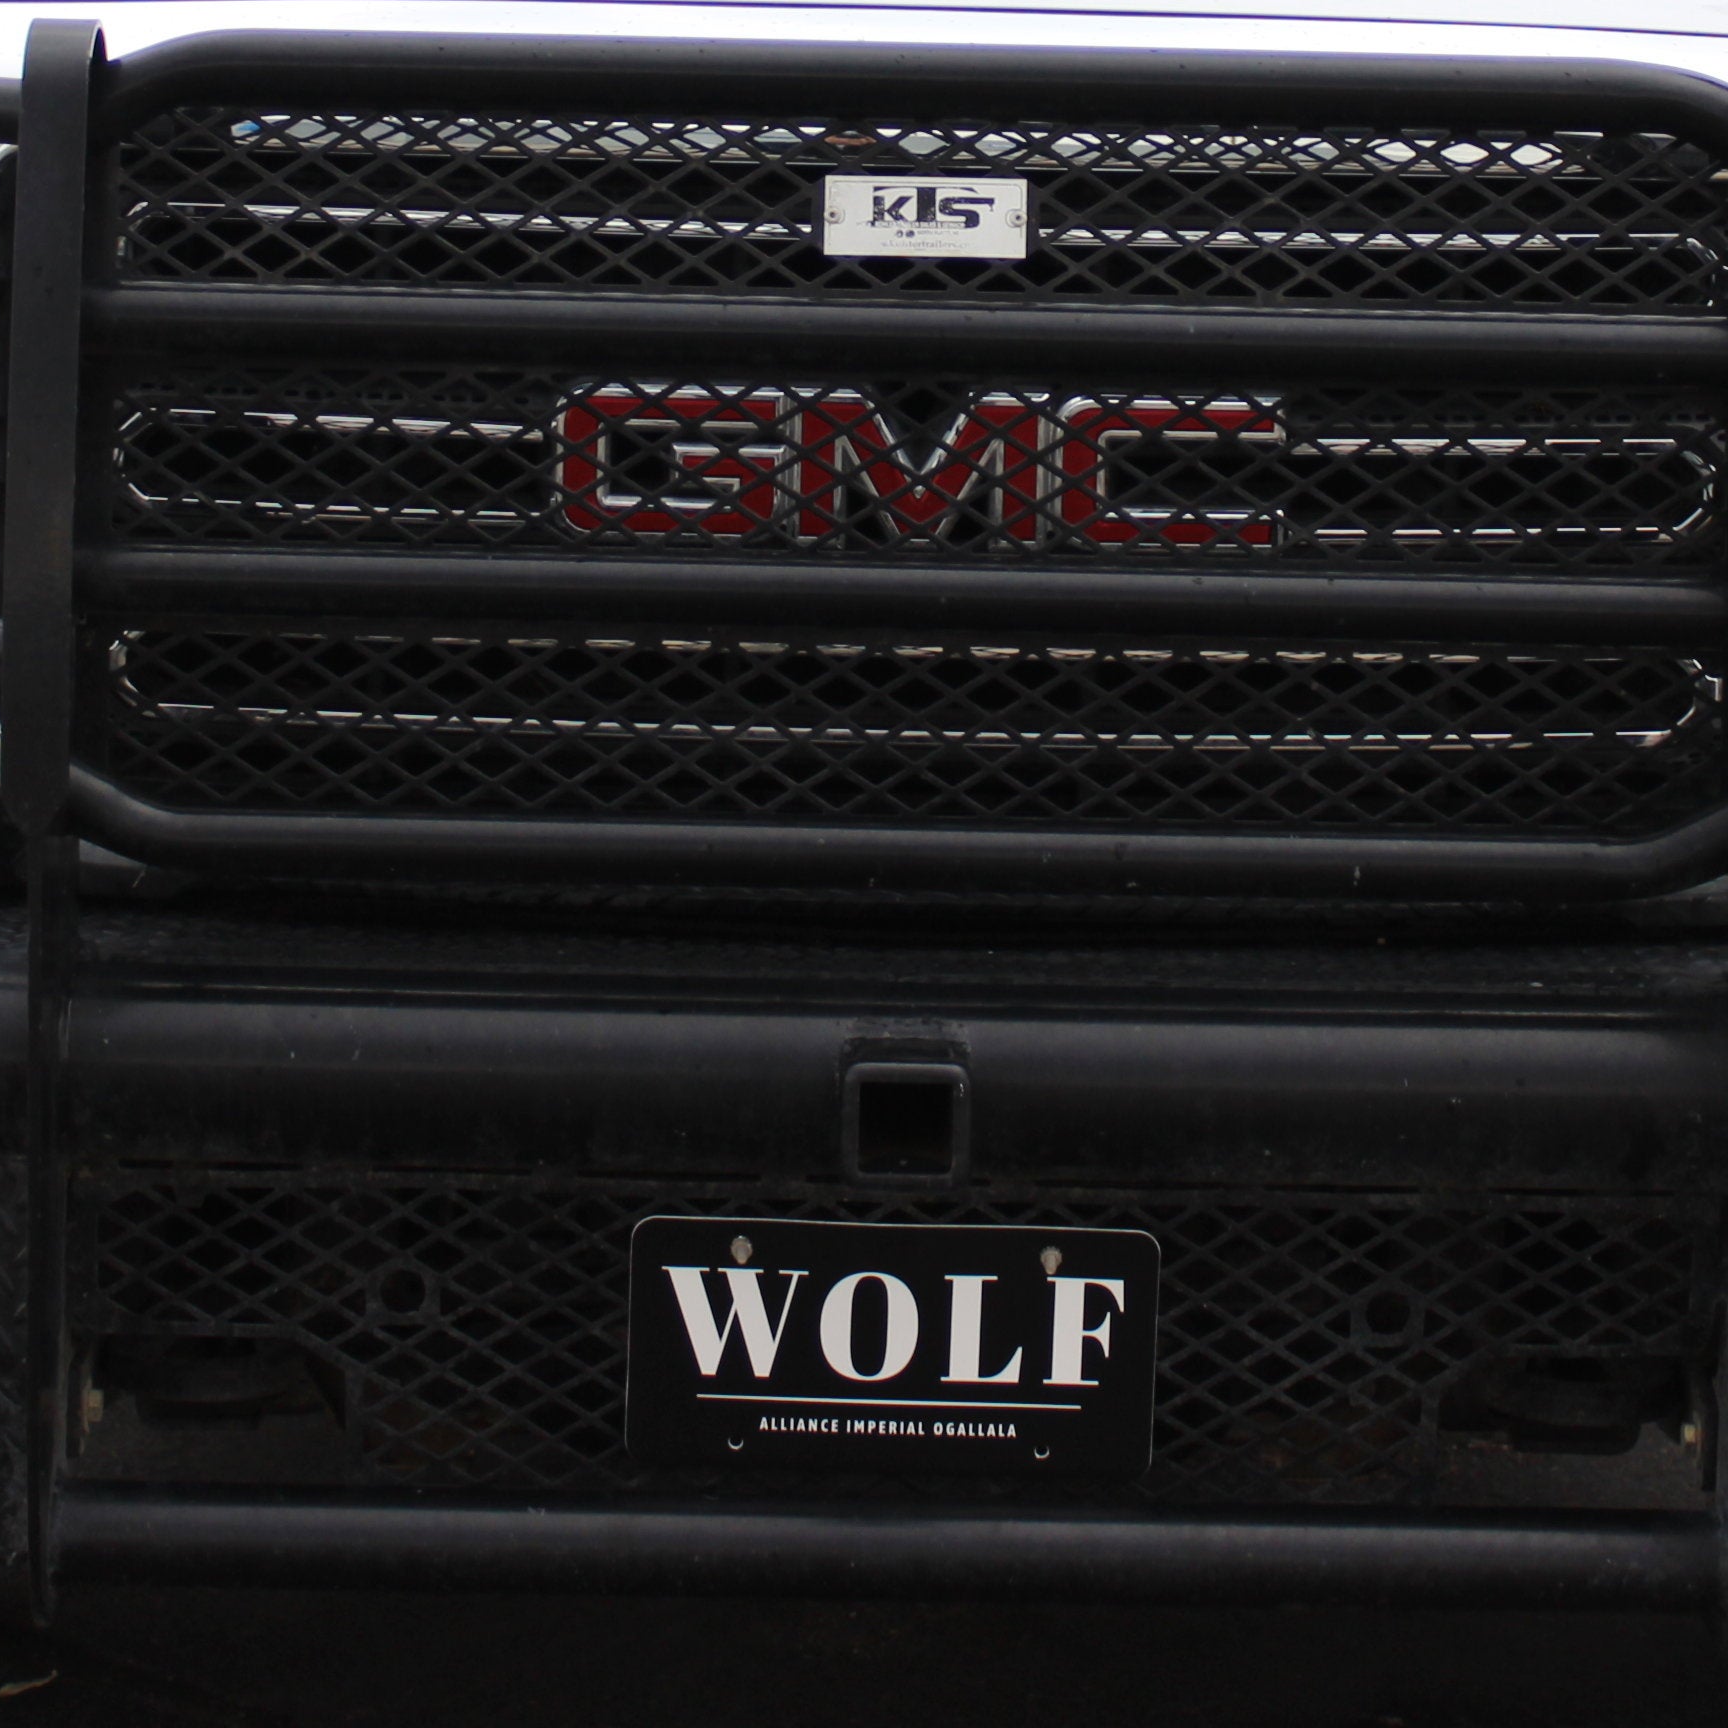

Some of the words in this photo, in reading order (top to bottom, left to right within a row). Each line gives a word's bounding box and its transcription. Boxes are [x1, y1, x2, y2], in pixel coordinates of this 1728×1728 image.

[554, 381, 1286, 552] GMC
[661, 1265, 1126, 1386] WOLF
[758, 1416, 840, 1434] ALLIANCE
[845, 1419, 926, 1436] IMPERIAL
[932, 1421, 1018, 1439] OGALLALA
